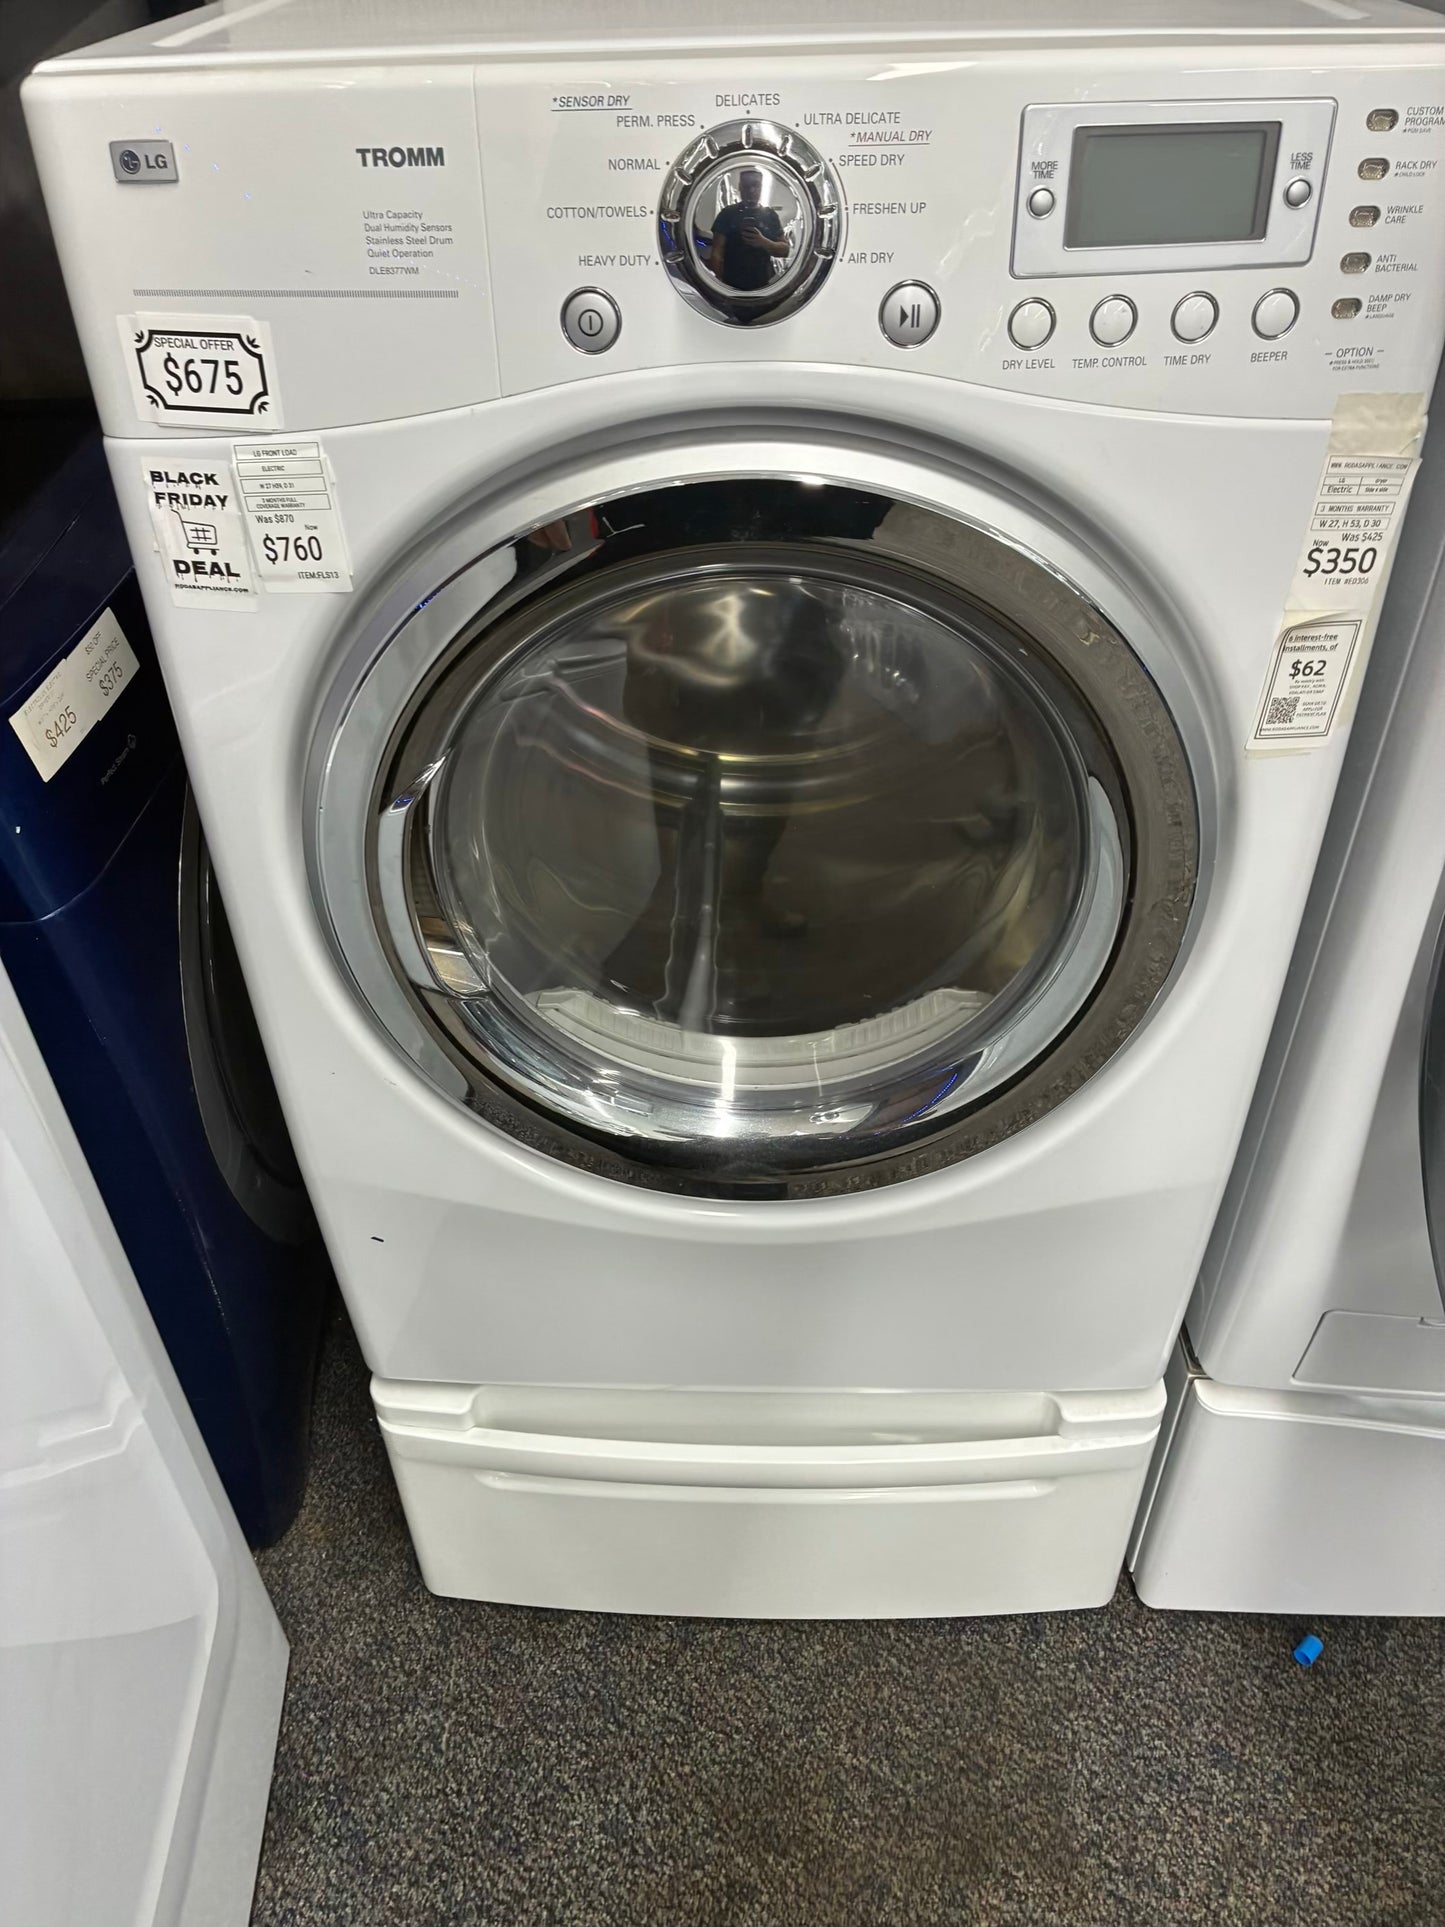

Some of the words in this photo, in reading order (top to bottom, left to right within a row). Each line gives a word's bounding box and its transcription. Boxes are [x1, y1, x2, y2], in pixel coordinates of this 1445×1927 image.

[607, 95, 630, 107] DRY
[715, 93, 781, 107] DELICATES
[1406, 106, 1444, 116] CUSTOM
[616, 115, 653, 128] PERM.
[657, 114, 696, 127] PRESS
[803, 112, 842, 125] ULTRA
[845, 111, 901, 125] DELICATE
[908, 130, 933, 142] DRY
[144, 153, 168, 169] LG
[355, 146, 445, 168] TROMM
[839, 155, 878, 167] SPEED
[880, 154, 905, 166] DRY
[1291, 152, 1314, 162] LESS
[608, 158, 661, 171] NORMAL
[1031, 160, 1058, 171] MORE
[1290, 161, 1312, 170] TIME
[1395, 160, 1418, 170] RACK
[1419, 160, 1438, 169] DRY
[1033, 170, 1054, 179] TIME
[546, 206, 647, 219] COTTON/TOWELS
[852, 202, 905, 215] FRESHEN
[909, 202, 927, 214] UP
[1386, 204, 1424, 215] WRINKLE
[362, 210, 384, 220] Ultra
[386, 209, 423, 221] Capacity
[1384, 215, 1407, 224] CARE
[364, 223, 382, 233] Dual
[384, 222, 419, 234] Humidity
[420, 222, 453, 232] Sensors
[365, 236, 404, 245] Stainless
[405, 235, 427, 245] Steel
[429, 235, 453, 245] Drum
[367, 248, 391, 258] Quiet
[392, 248, 434, 259] Operation
[848, 252, 868, 264] AIR
[870, 252, 894, 264] DRY
[1376, 254, 1397, 263] ANTI
[578, 255, 616, 267] HEAVY
[619, 255, 651, 267] DUTY
[1374, 263, 1418, 273] BACTERIAL
[1368, 293, 1393, 303] DAMP
[1394, 292, 1412, 302] DRY
[1366, 303, 1387, 313] BEEP
[154, 336, 199, 350] SPECIAL
[200, 339, 235, 351] OFFER
[1250, 350, 1289, 364] BEEPER
[1336, 346, 1374, 359] OPTION
[1002, 358, 1024, 371] DRY
[1025, 358, 1056, 370] LEVEL
[1072, 357, 1099, 370] TEMP.
[1101, 355, 1148, 368] CONTROL
[1164, 355, 1189, 366] TIME
[1190, 353, 1212, 366] DRY
[163, 352, 244, 397] $675
[262, 449, 281, 457] FRONT
[261, 465, 285, 473] ELECTRIC
[149, 470, 220, 486] BLACK
[1326, 486, 1353, 494] Electric
[153, 491, 229, 508] FRIDAY
[1328, 505, 1354, 513] MONTHS
[1356, 504, 1391, 513] WARRANTY
[255, 515, 273, 524] Was
[274, 514, 294, 524] $870
[1319, 519, 1326, 528] W
[1328, 519, 1340, 529] 27,
[1341, 519, 1349, 528] H
[1350, 519, 1362, 529] 53,
[1363, 519, 1370, 528] D
[1371, 518, 1382, 528] 30
[1312, 538, 1330, 547] Now
[1341, 532, 1360, 542] Was
[1361, 531, 1383, 543] $425
[263, 533, 323, 565] $760
[1303, 546, 1378, 578] $350
[172, 559, 241, 578] DEAL
[1324, 577, 1342, 586] ITEM
[1294, 632, 1339, 643] interest-free
[1329, 642, 1339, 652] of
[1289, 658, 1328, 680] $62
[98, 660, 124, 697] $375
[45, 705, 77, 748] $425
